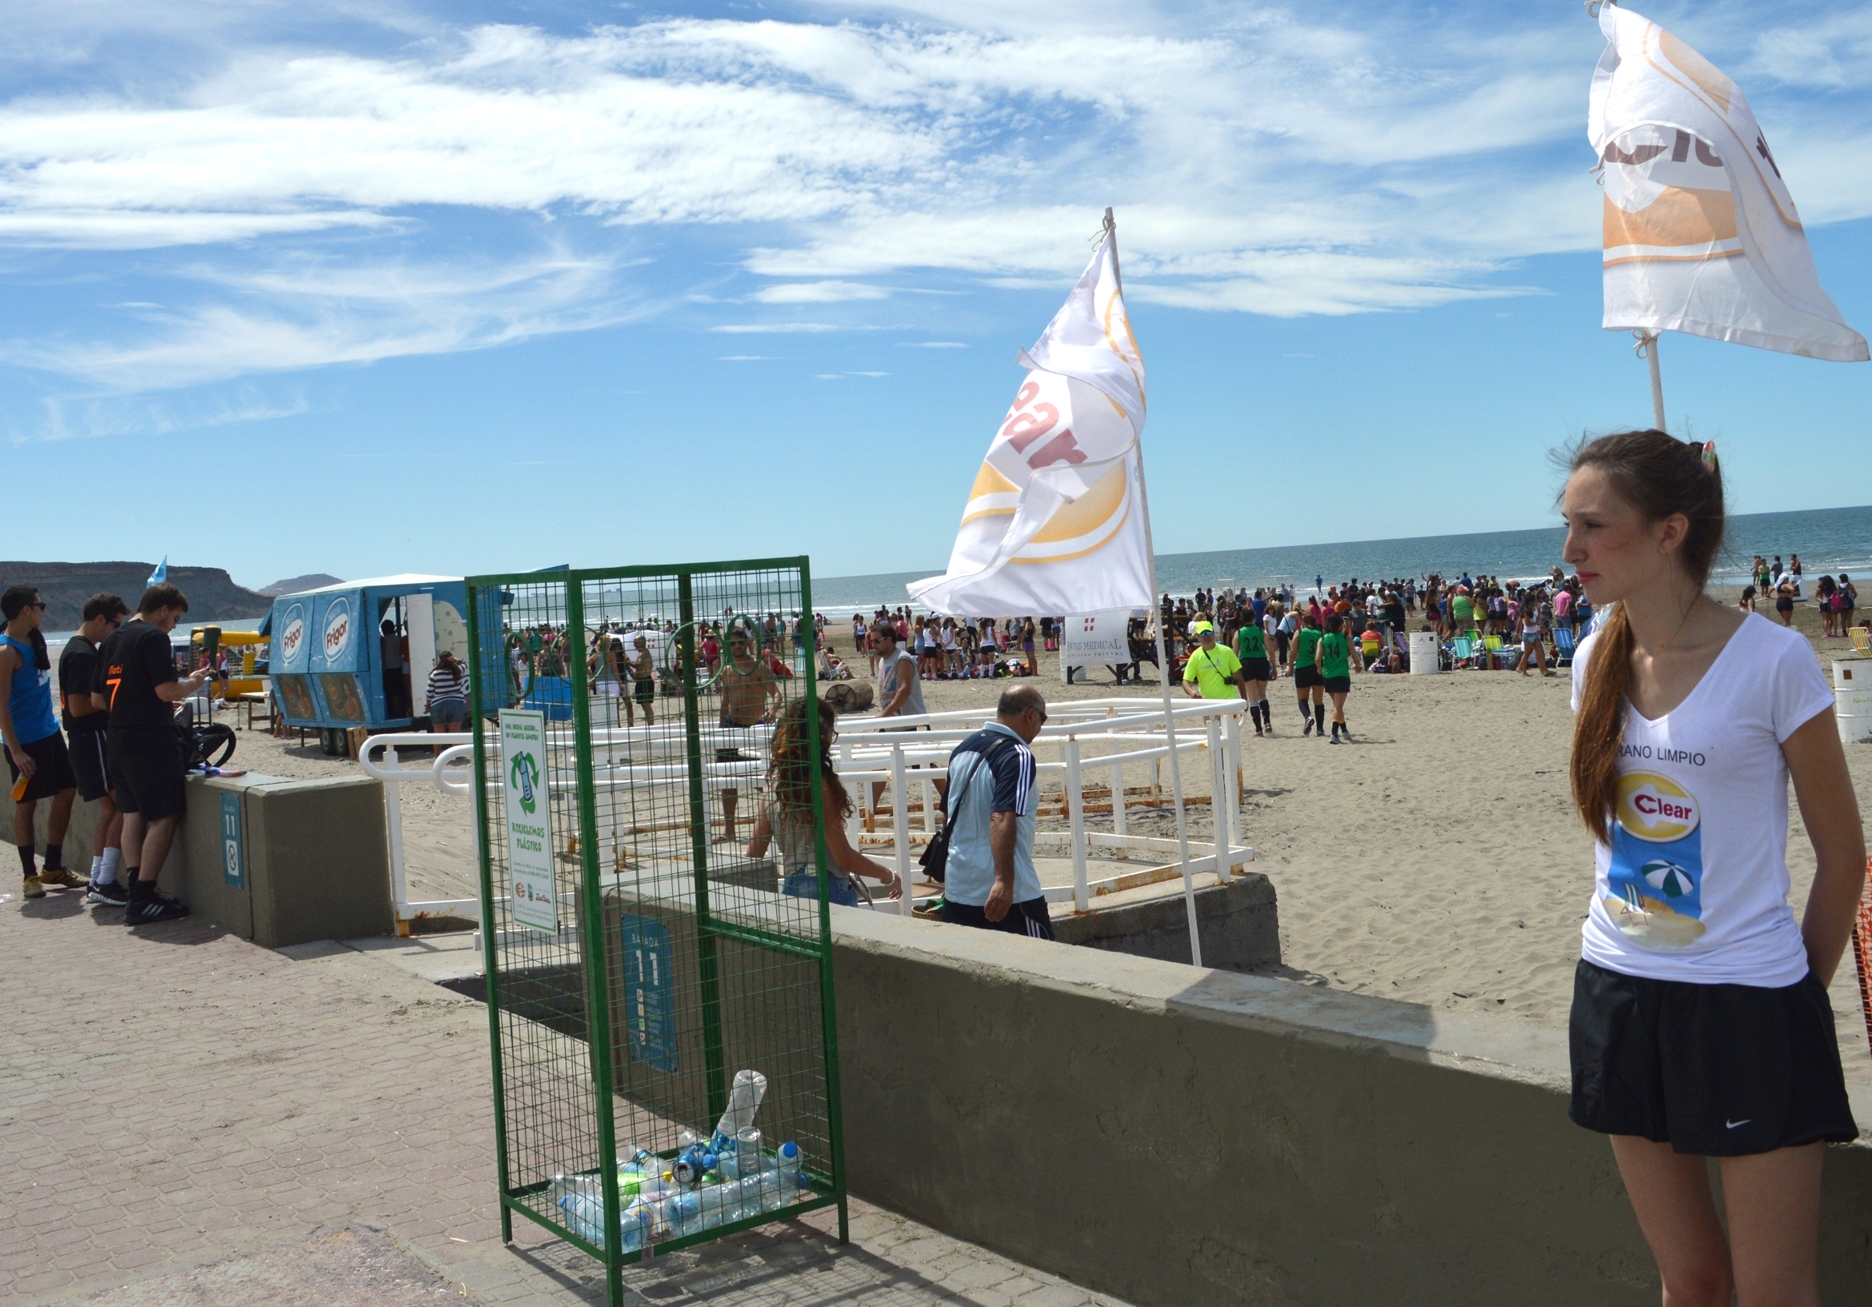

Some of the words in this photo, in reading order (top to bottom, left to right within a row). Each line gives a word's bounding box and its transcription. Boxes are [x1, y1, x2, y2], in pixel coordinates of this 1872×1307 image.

[283, 625, 302, 652] Frigor
[326, 620, 348, 650] Frigor
[1084, 638, 1122, 650] MEDICAL
[1244, 636, 1260, 652] 22
[1327, 643, 1341, 659] 14
[106, 678, 122, 713] 7
[1615, 744, 1652, 759] RANO
[1657, 747, 1706, 767] LIMPIO
[1634, 794, 1692, 820] Clear
[225, 814, 235, 836] 11
[512, 822, 545, 838] RECICLEMOS
[516, 837, 542, 853] PLÁSTICO
[636, 949, 659, 986] 11
